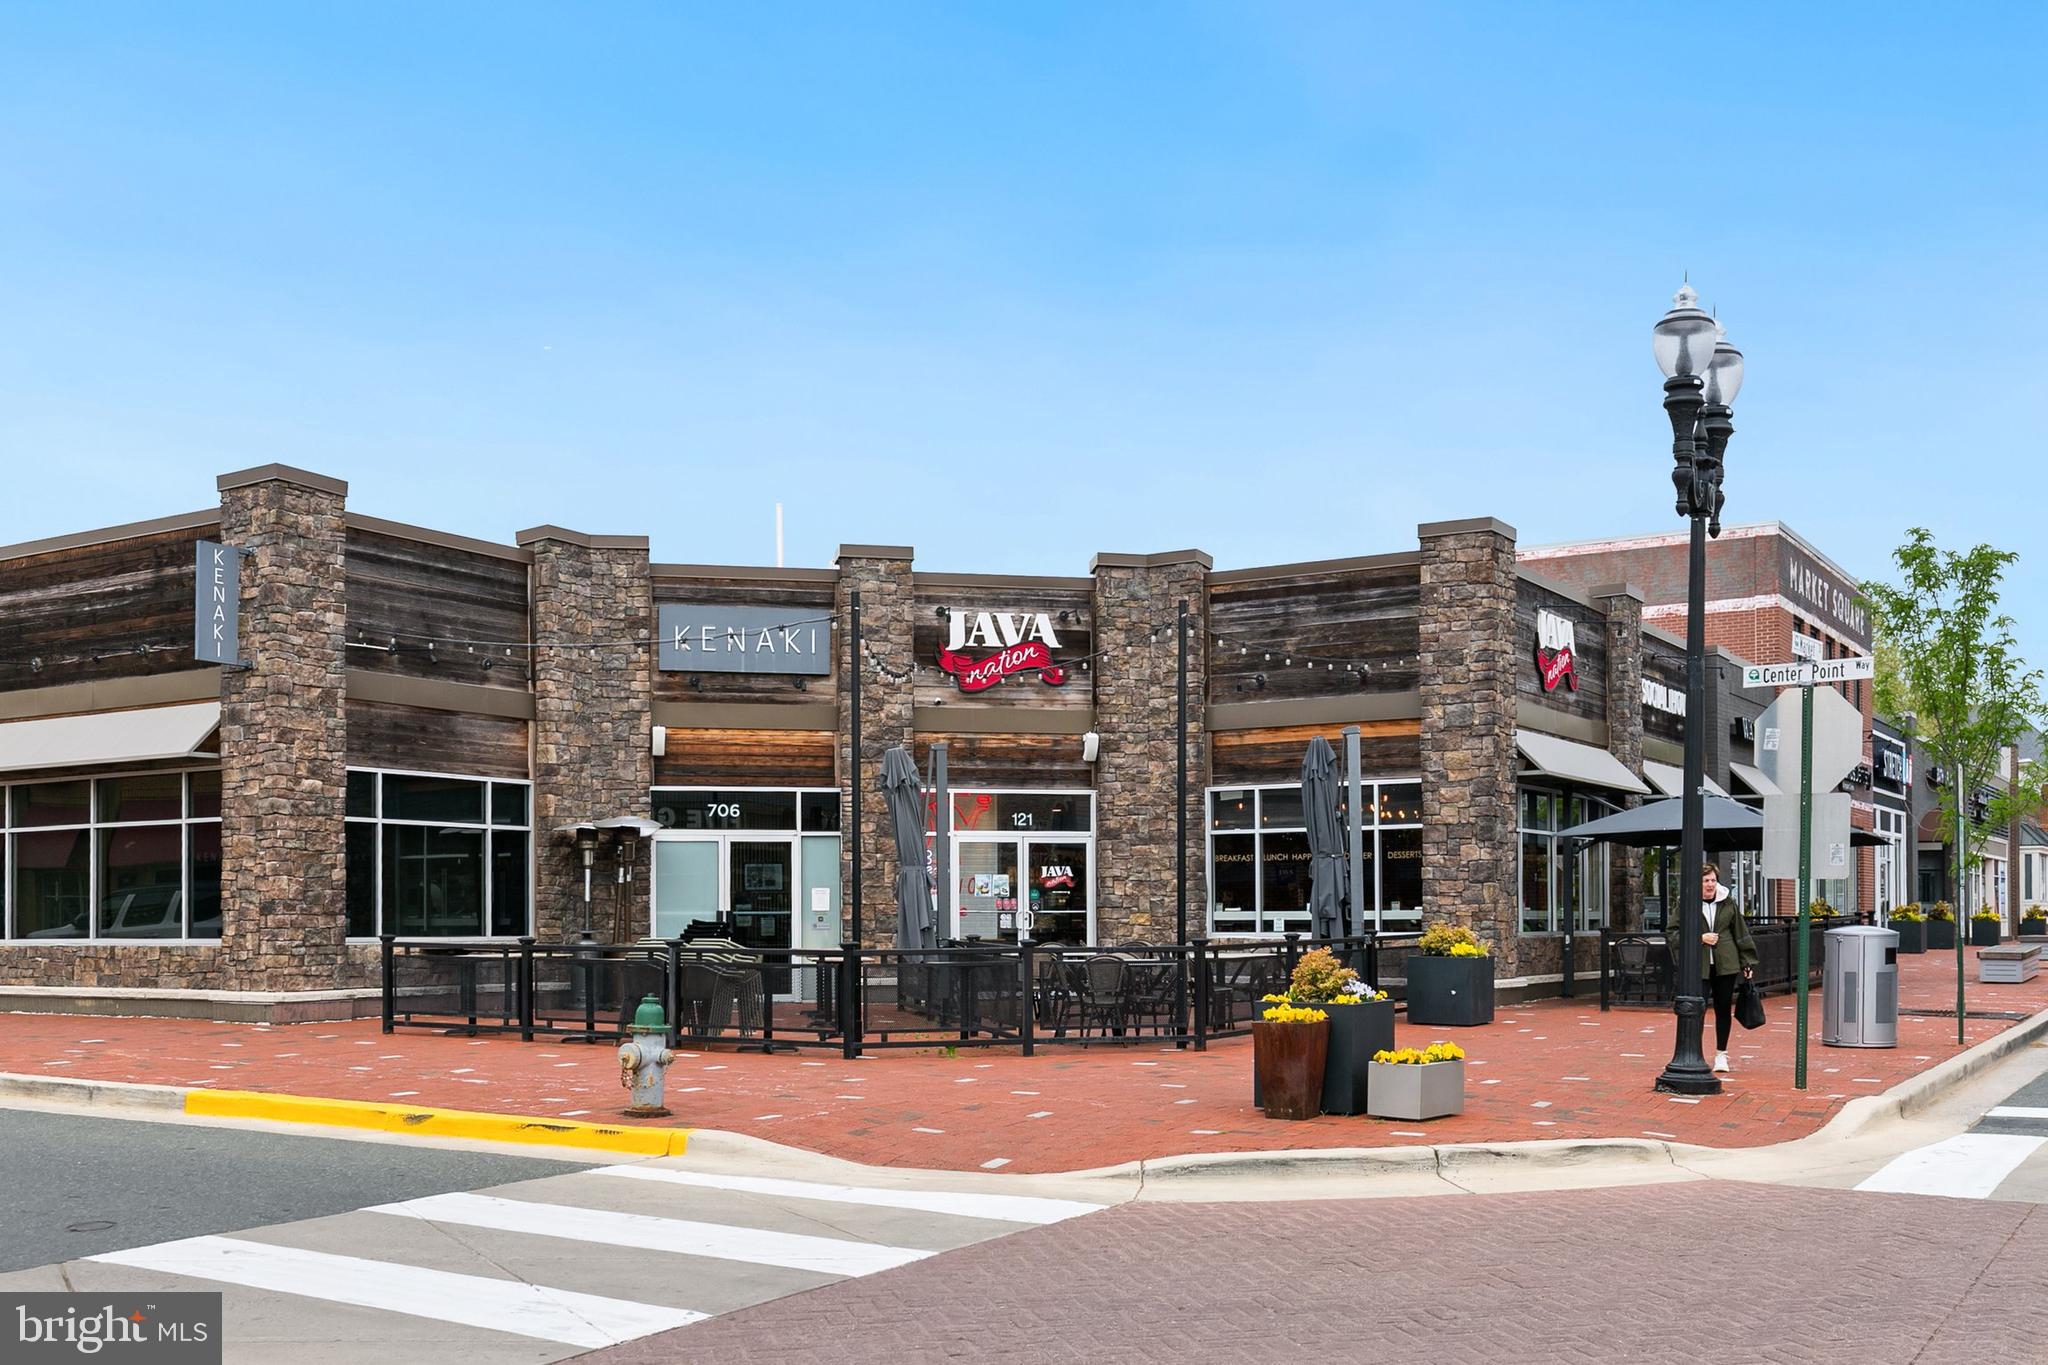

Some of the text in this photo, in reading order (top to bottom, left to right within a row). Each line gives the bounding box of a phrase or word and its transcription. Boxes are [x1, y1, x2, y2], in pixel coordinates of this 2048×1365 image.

[213, 548, 225, 658] KENAKI
[1790, 557, 1864, 636] MARKET SQUARE
[674, 625, 816, 654] KENAKI
[945, 611, 1062, 650] JAVA
[1537, 609, 1577, 657] JAVA
[970, 646, 1039, 684] nation
[1763, 660, 1870, 684] Center Point Way
[707, 803, 740, 817] 706
[1011, 812, 1033, 826] 121
[1041, 865, 1074, 877] JAVA
[1215, 854, 1254, 863] BREAKFAST
[1263, 853, 1289, 862] LUNCH
[1292, 853, 1312, 861] HAPP
[1387, 850, 1422, 859] DESSERTS
